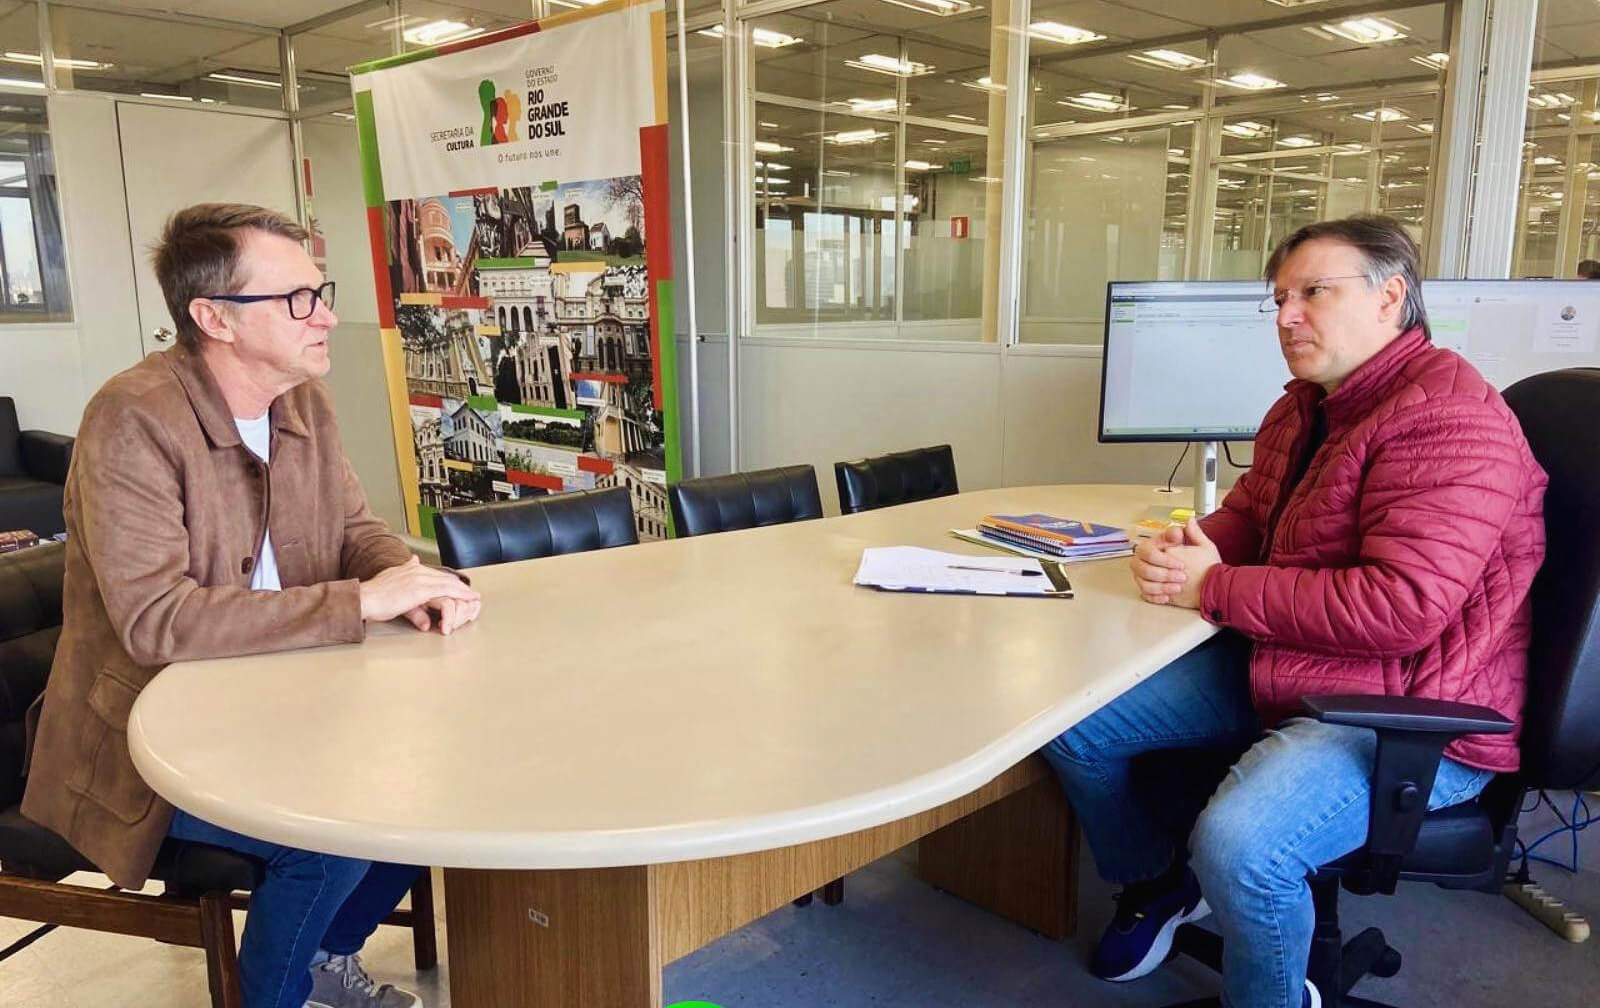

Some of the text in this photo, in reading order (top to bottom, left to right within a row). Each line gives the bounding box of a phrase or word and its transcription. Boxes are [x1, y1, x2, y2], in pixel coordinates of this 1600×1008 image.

[525, 66, 555, 78] GOVERNO
[527, 74, 558, 88] DO ESTADO
[528, 89, 545, 105] RIO
[528, 101, 569, 122] GRANDE
[431, 127, 474, 143] SECRETARIA DA
[529, 120, 566, 140] DO SUL
[446, 140, 474, 151] CULTURA
